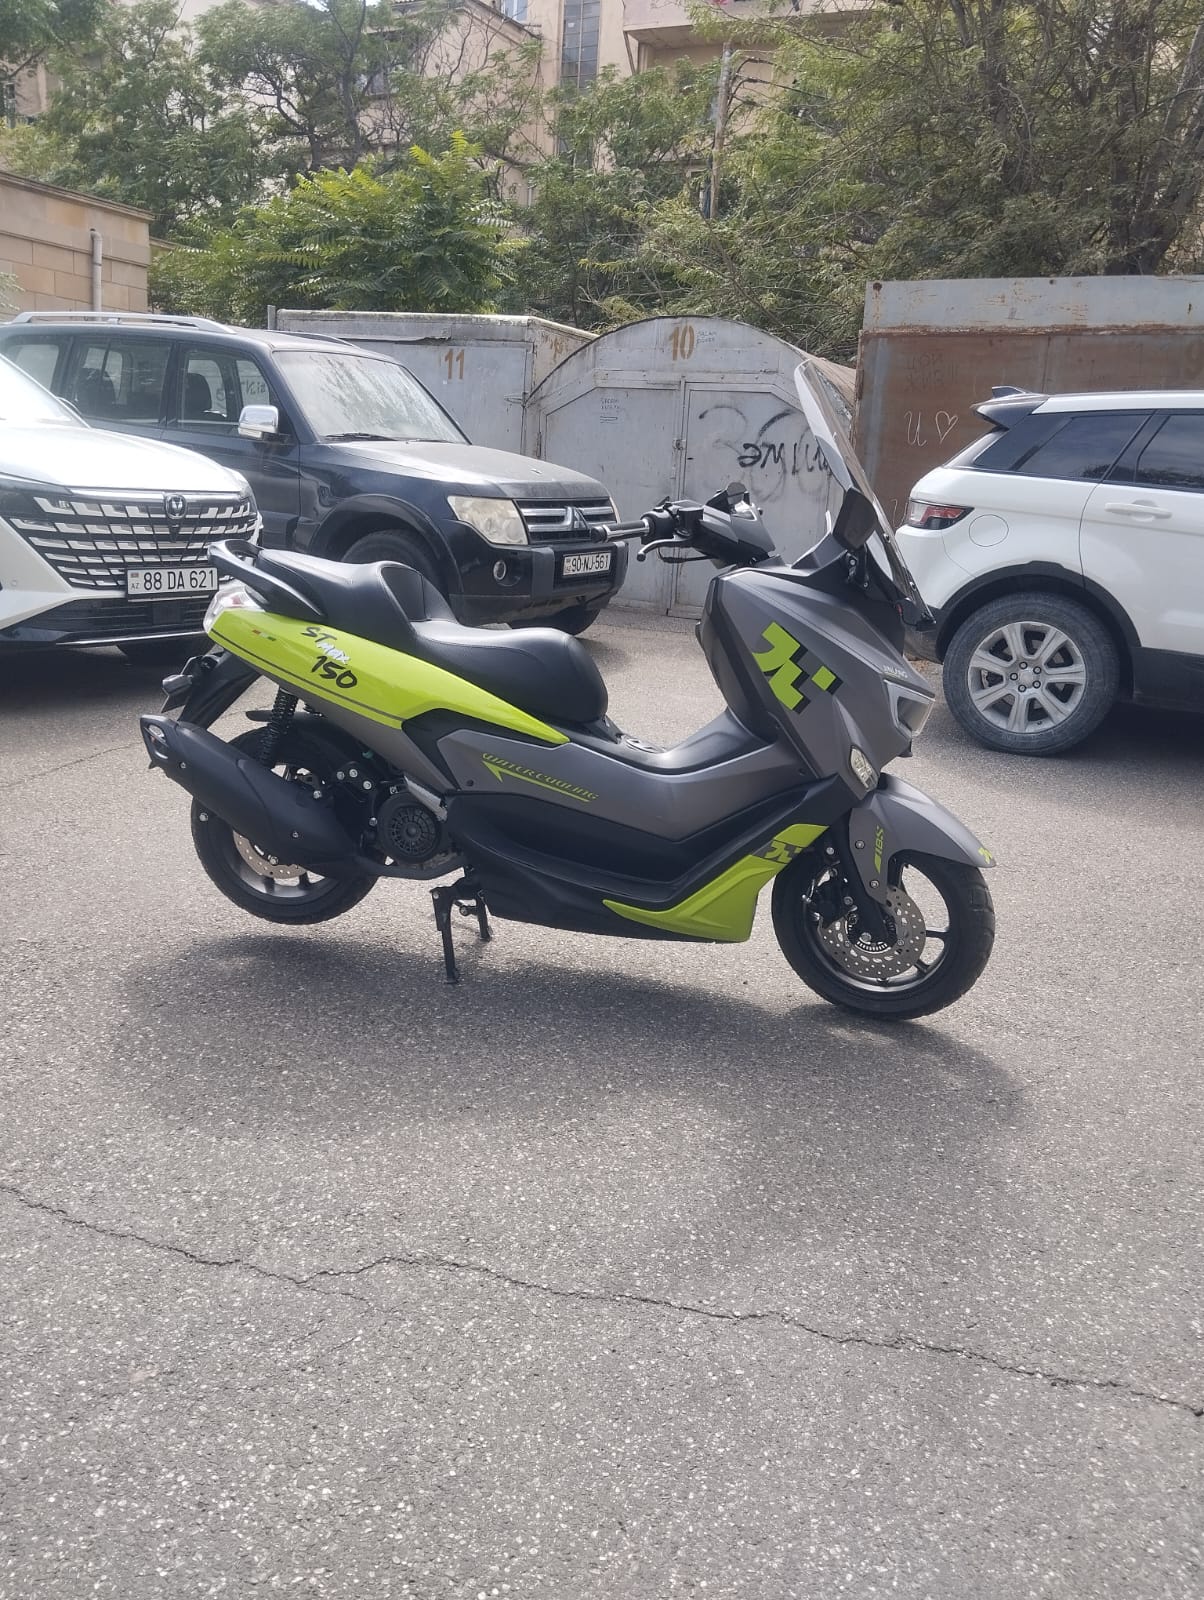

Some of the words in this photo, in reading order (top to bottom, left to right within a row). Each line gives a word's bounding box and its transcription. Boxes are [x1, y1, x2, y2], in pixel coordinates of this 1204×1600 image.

[669, 325, 695, 360] 10
[444, 350, 465, 380] 11
[131, 582, 140, 590] AZ
[143, 572, 162, 590] 88
[167, 571, 185, 590] DA
[189, 569, 214, 588] 621
[301, 626, 338, 643] ST
[310, 655, 358, 689] 150
